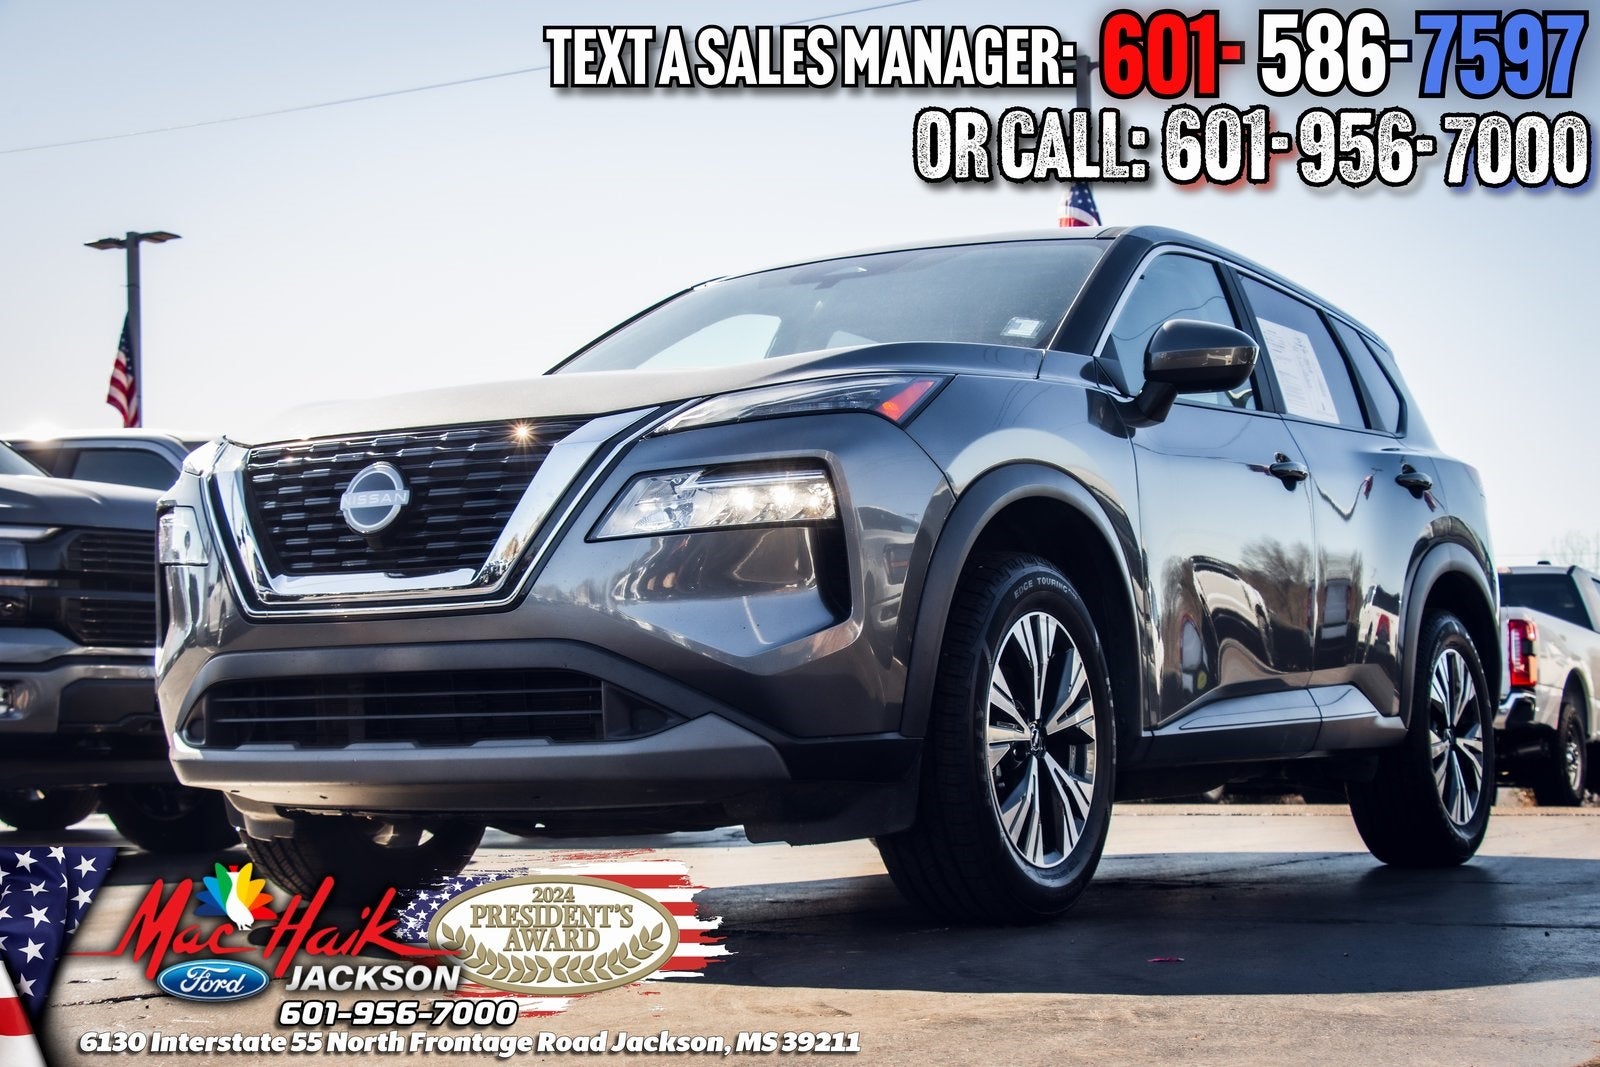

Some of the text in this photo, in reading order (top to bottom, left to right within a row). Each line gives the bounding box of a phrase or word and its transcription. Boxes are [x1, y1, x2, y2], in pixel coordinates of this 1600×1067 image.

[342, 493, 407, 507] NISSAN
[1013, 576, 1068, 600] EDGE TOURING
